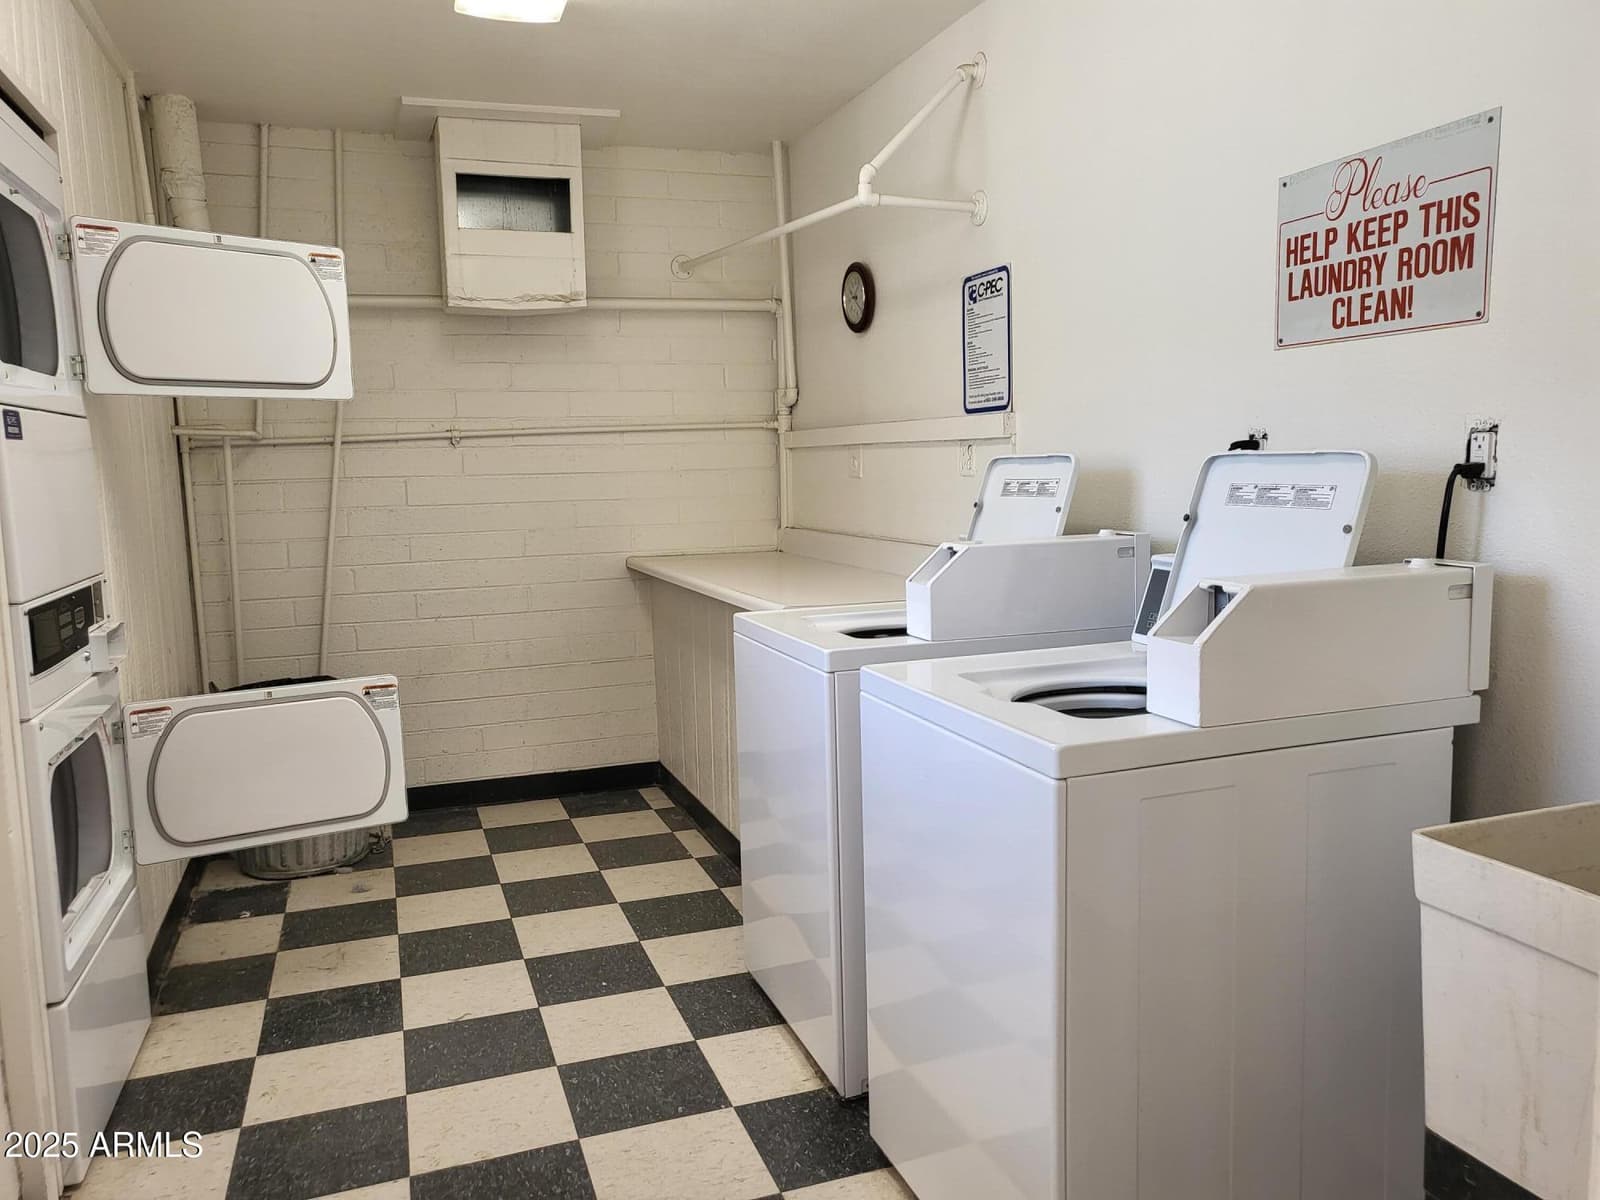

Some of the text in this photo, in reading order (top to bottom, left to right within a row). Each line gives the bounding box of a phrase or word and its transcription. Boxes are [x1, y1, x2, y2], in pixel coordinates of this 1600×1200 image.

[1325, 156, 1427, 221] Please
[1286, 192, 1480, 268] HELP KEEP THIS
[1288, 233, 1475, 301] LAUNDRY ROOM
[1331, 285, 1414, 329] CLEAN!
